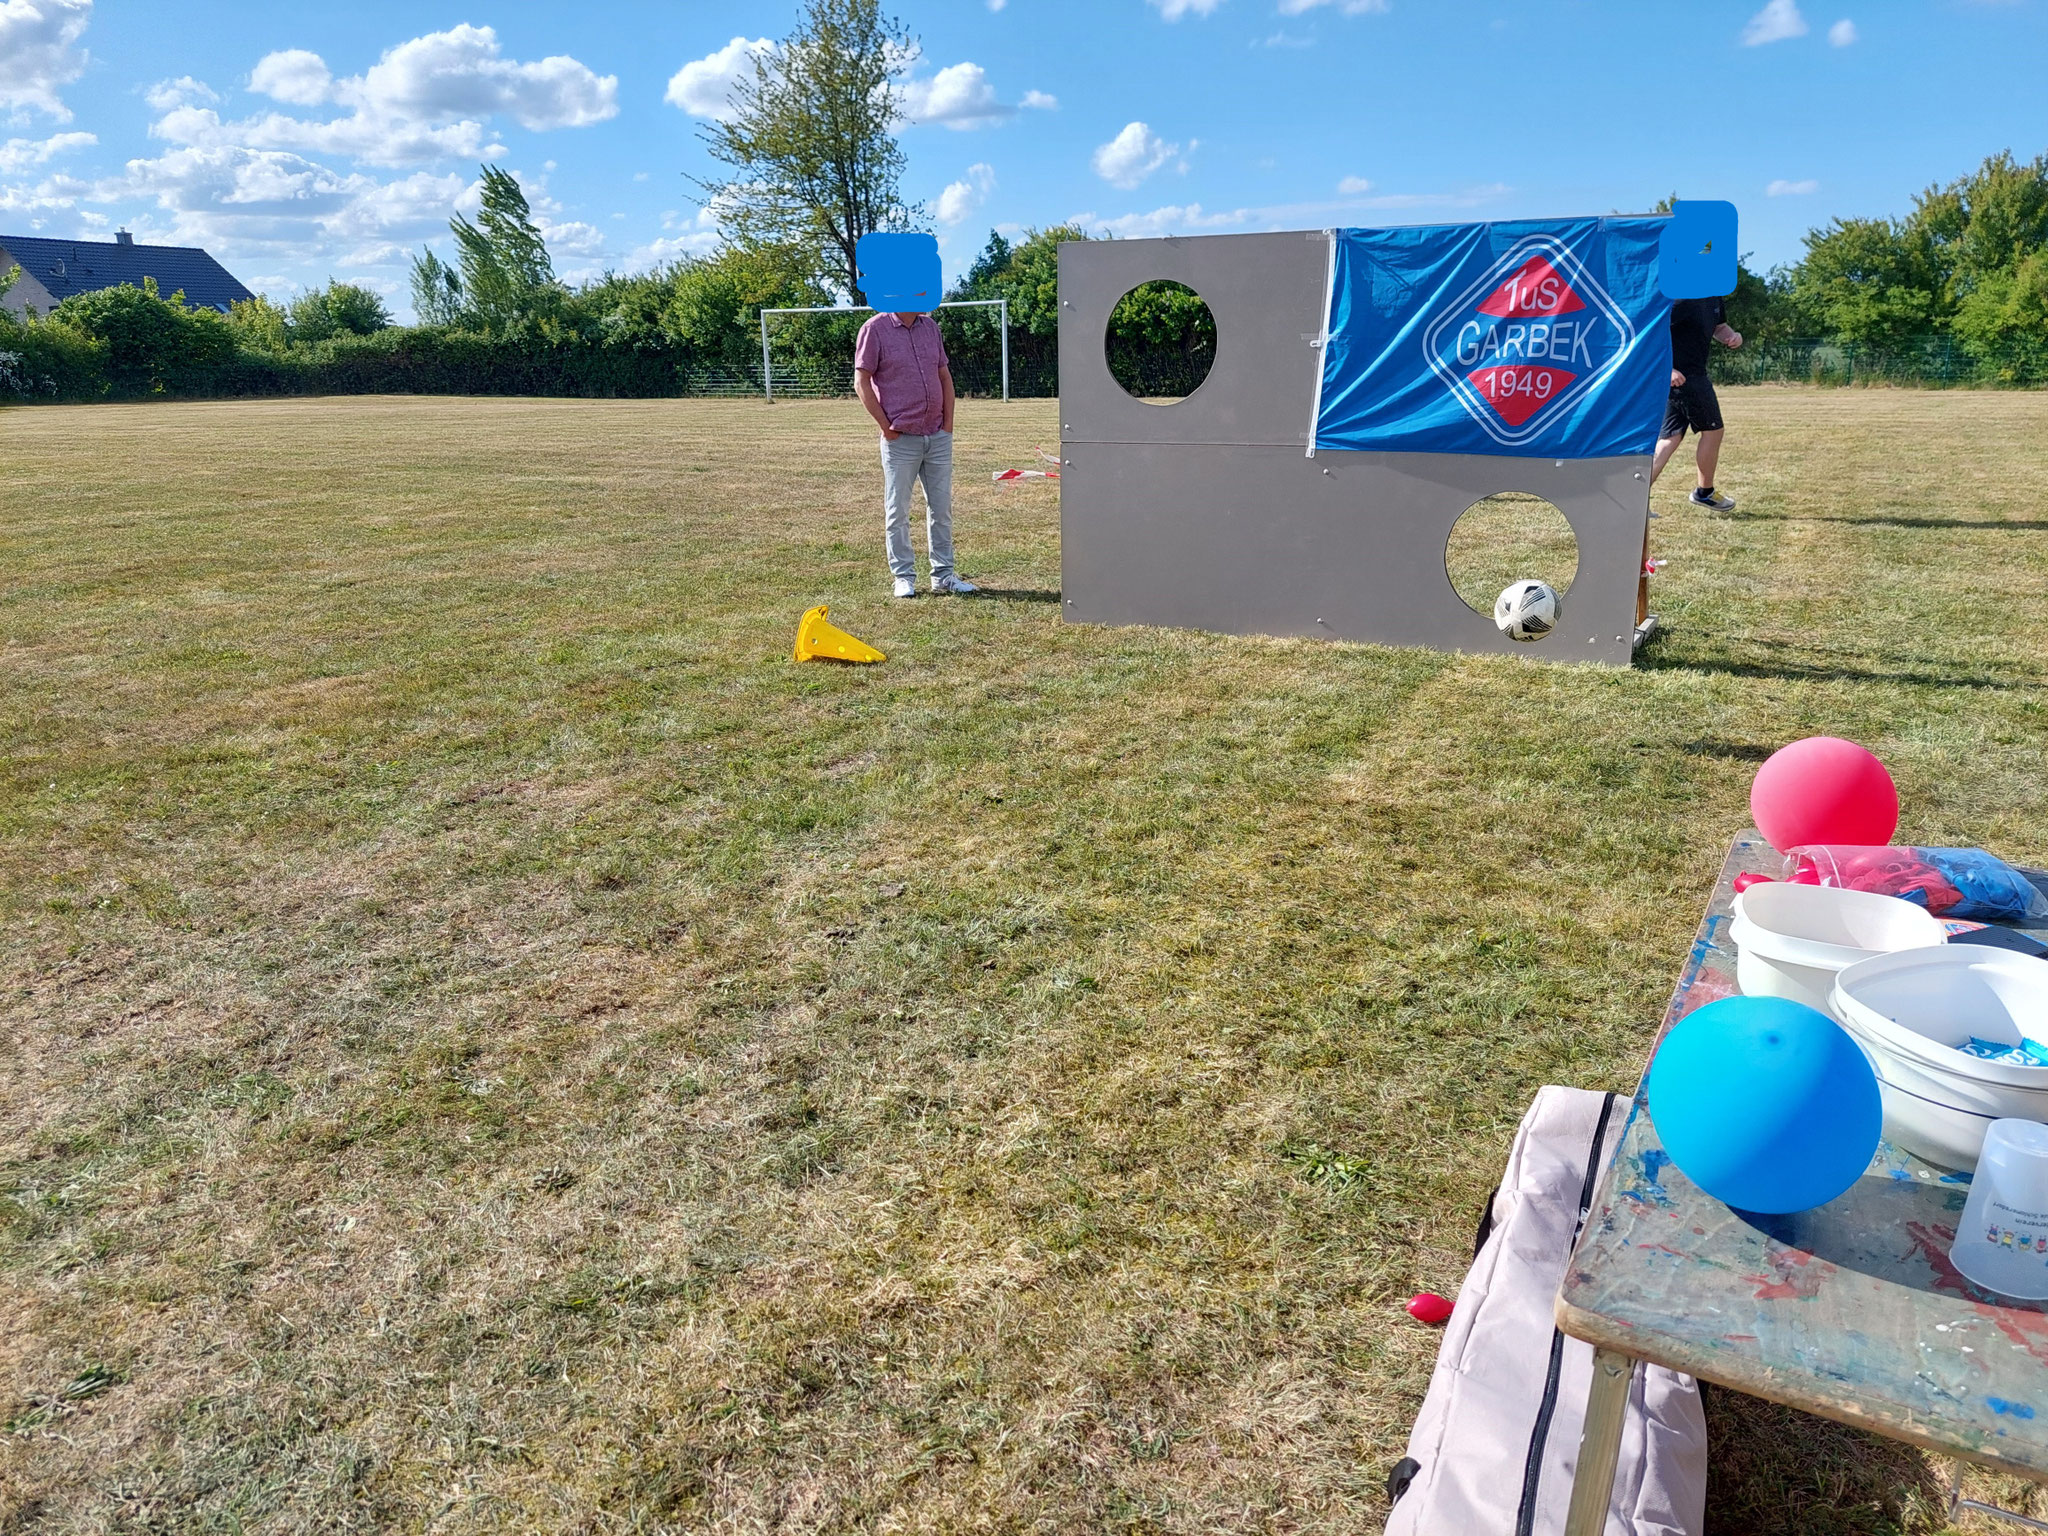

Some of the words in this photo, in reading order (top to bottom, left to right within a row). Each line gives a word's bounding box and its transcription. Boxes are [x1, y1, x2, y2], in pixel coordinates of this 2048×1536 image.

[1503, 269, 1559, 312] TuS
[1456, 316, 1598, 369] GARBEK
[1484, 370, 1552, 399] 1949
